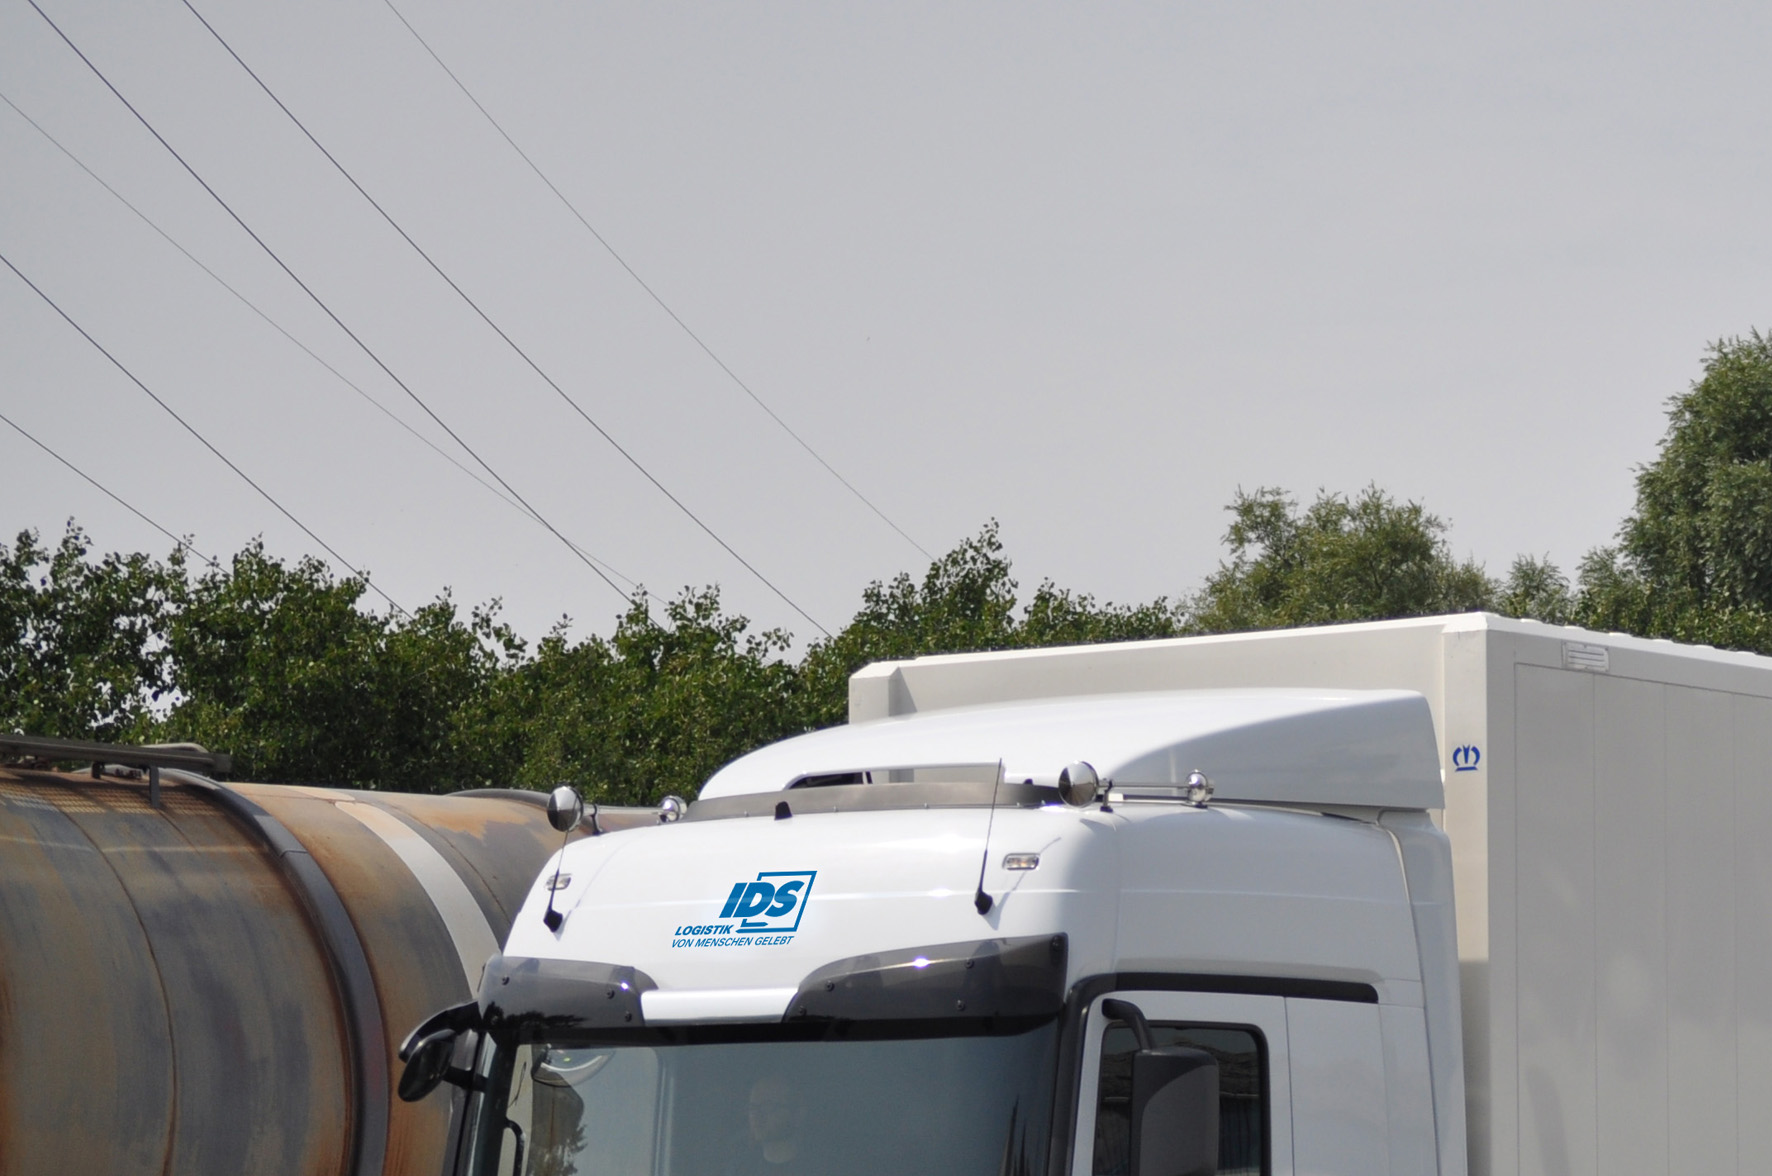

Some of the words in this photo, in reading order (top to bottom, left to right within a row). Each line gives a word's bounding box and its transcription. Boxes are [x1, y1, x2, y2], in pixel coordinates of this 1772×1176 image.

[719, 880, 805, 918] IDS
[674, 924, 734, 936] LOGISTIK
[672, 939, 693, 948] VON
[695, 937, 754, 947] MENSCHEN
[754, 935, 795, 946] GELEBT
